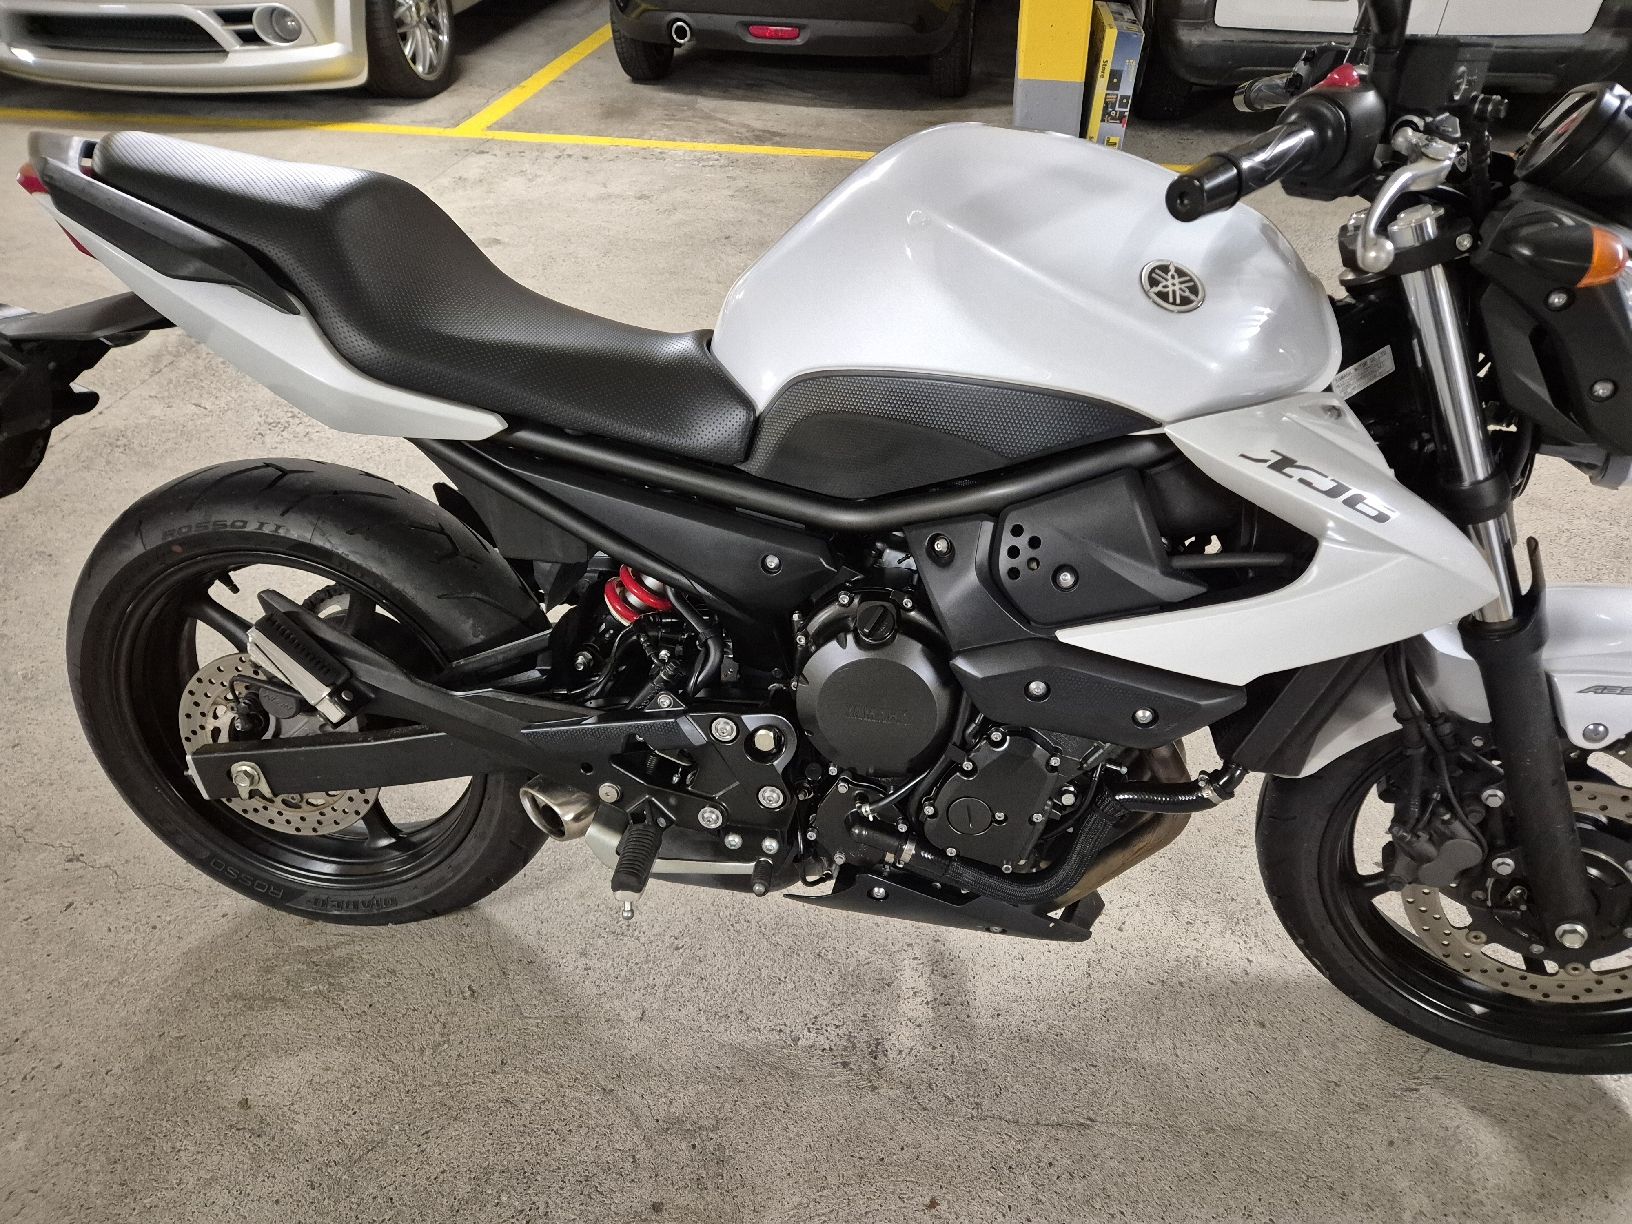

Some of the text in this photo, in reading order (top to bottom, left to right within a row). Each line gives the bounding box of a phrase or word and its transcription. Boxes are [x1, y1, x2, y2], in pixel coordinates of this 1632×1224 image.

[1238, 450, 1398, 523] XJ6
[162, 519, 248, 541] ROSSO
[210, 856, 284, 899] ROSSO
